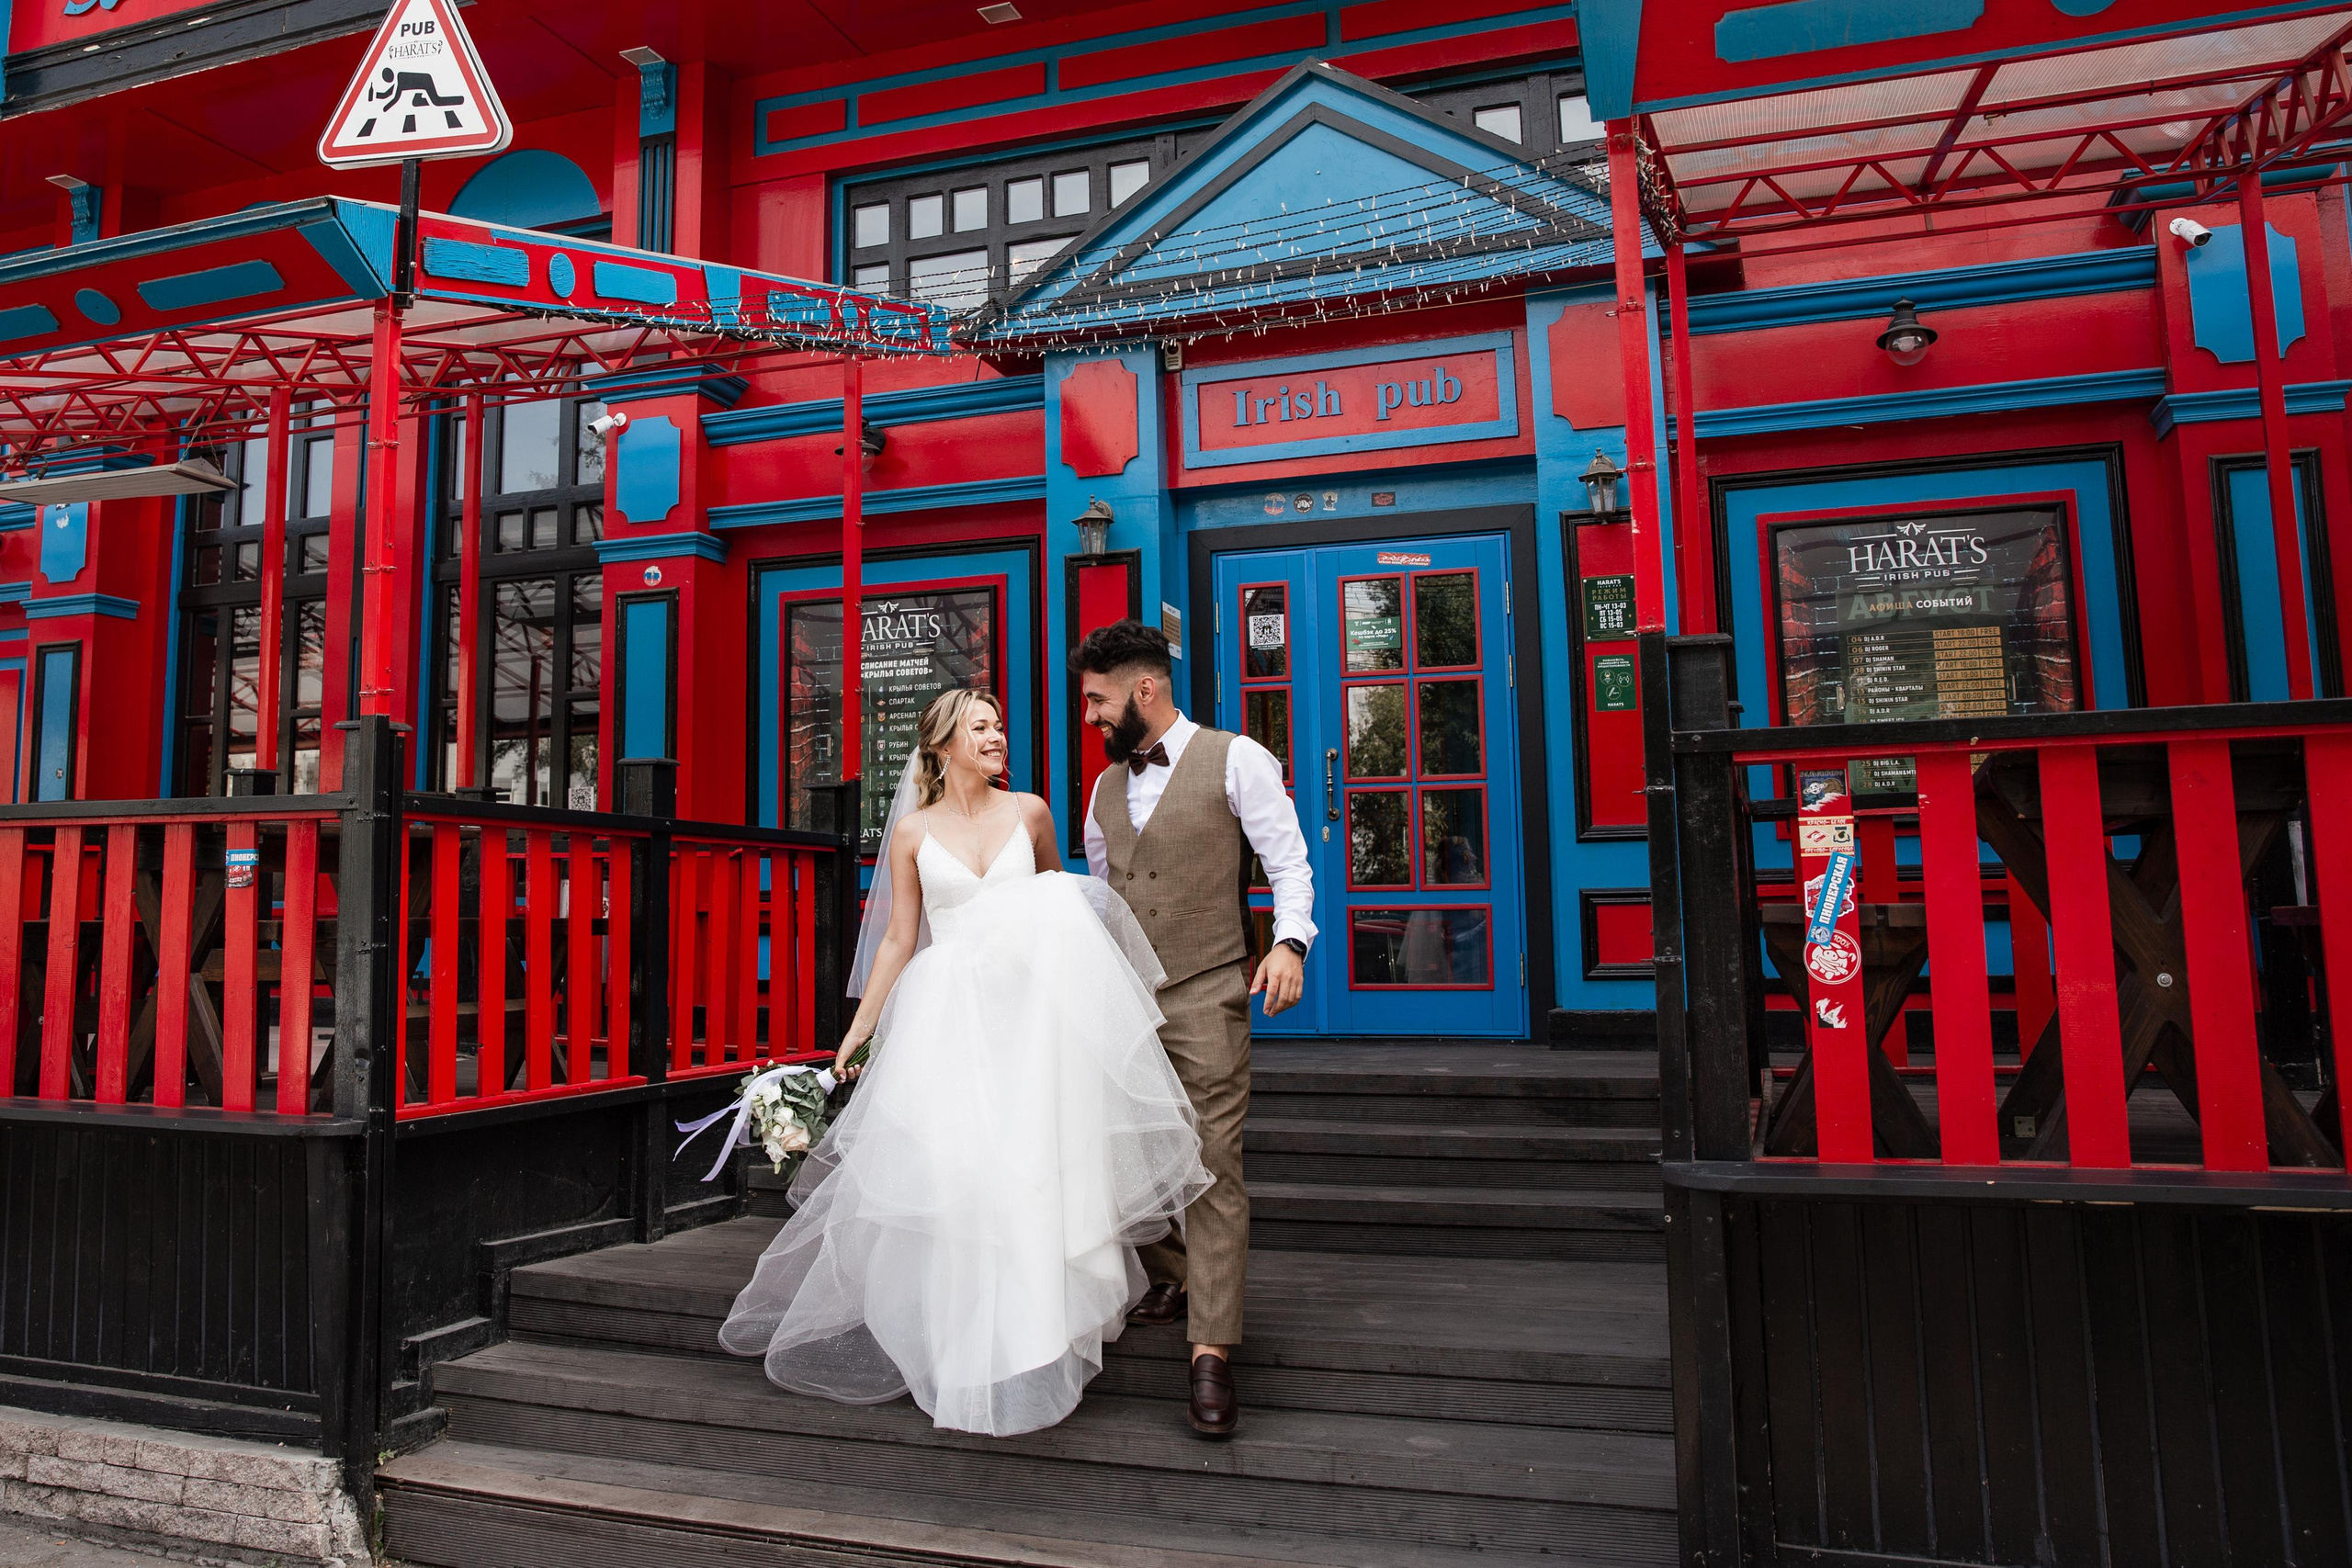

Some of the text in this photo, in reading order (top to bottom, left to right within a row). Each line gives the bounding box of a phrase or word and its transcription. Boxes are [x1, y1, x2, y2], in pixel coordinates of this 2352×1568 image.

[401, 21, 435, 37] PUB
[1232, 367, 1463, 427] Irish pub
[1847, 535, 1987, 574] HARAT'S
[1884, 570, 1951, 581] IRISH PUB
[1848, 585, 1995, 620] АВГУСТ
[1870, 596, 1973, 612] АФИША СОБЫТИЙ
[861, 613, 941, 642] ARAT'S
[861, 657, 929, 670] СПИСАНИЕ МАТЧЕЙ
[896, 668, 933, 676] СОВЕТОВ»
[231, 853, 259, 862] ПИОНЕРС
[1818, 855, 1849, 925] ПИОНЕРСКАЯ
[1833, 935, 1851, 948] 100%
